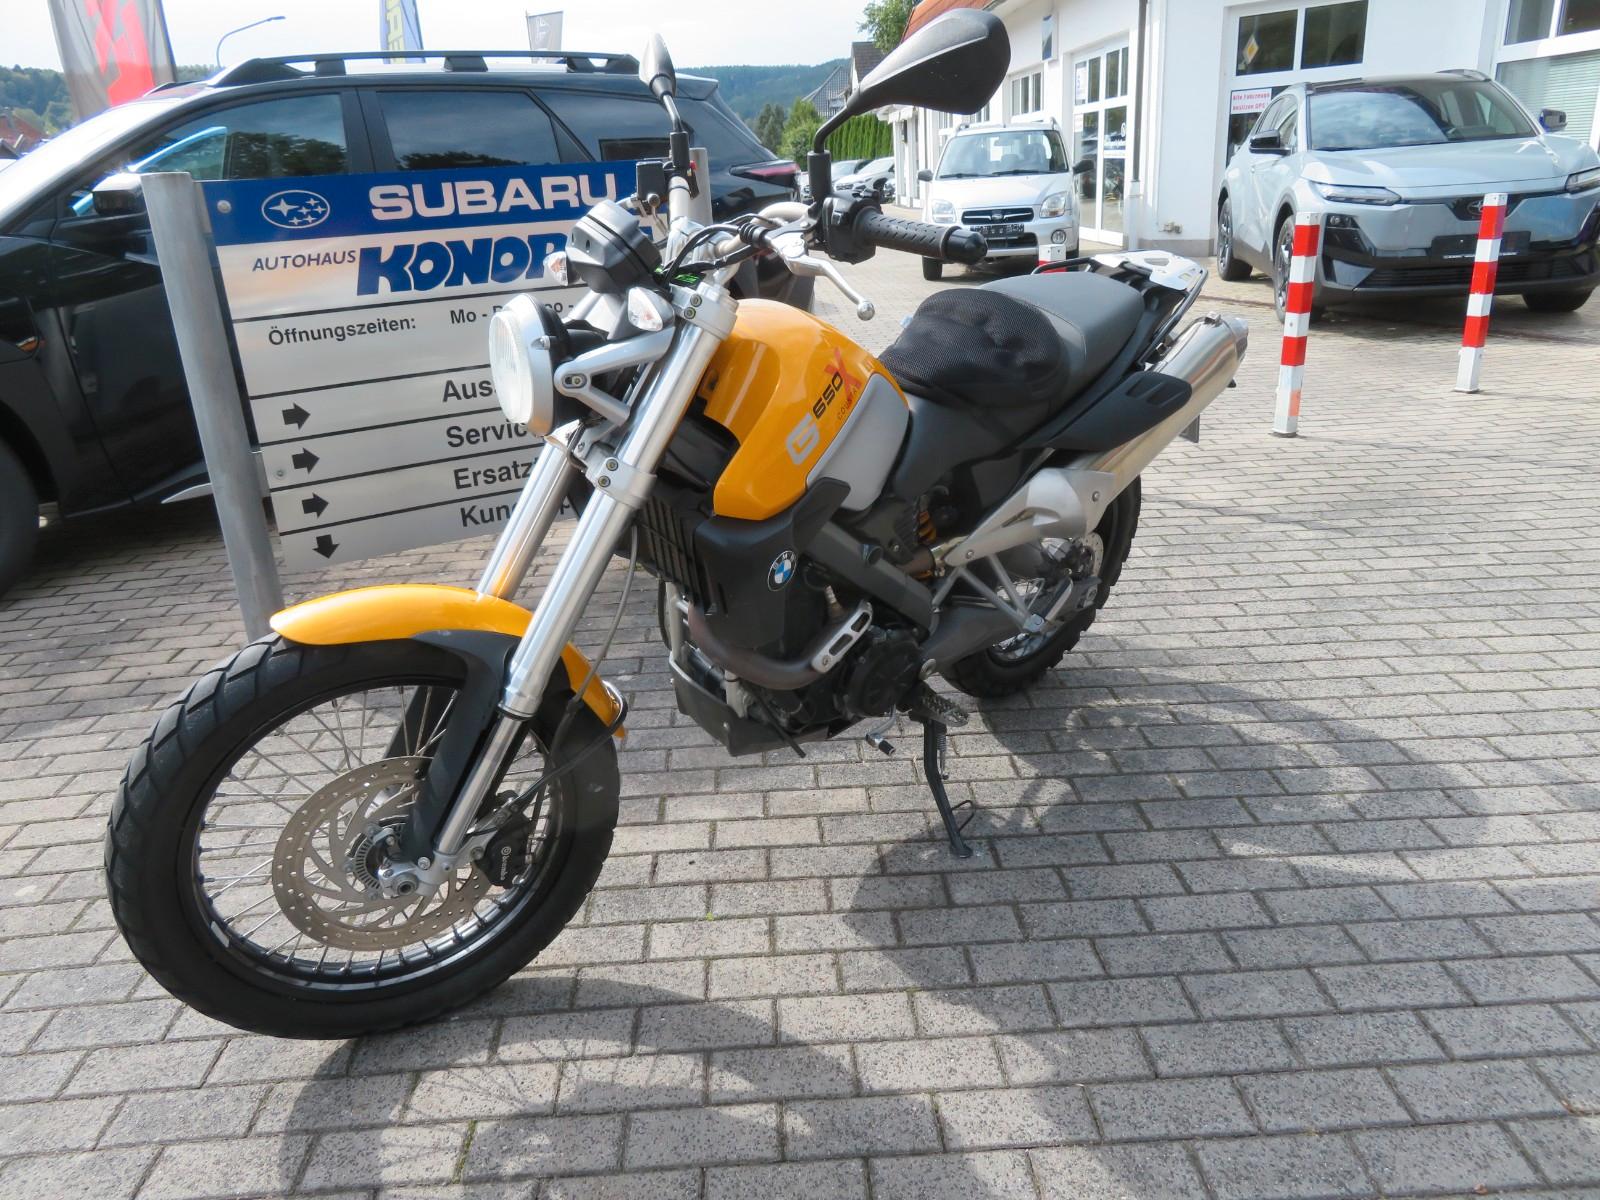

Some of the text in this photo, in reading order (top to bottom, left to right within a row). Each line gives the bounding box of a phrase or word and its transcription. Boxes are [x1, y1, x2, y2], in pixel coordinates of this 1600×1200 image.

[369, 173, 617, 221] SUBARU
[252, 250, 357, 272] AUTOHAUS
[268, 317, 417, 346] Öffnungszeiten:
[450, 309, 477, 325] Mo
[442, 379, 496, 402] Aus
[812, 371, 844, 420] 650
[446, 418, 529, 448] Servic
[454, 457, 539, 490] Ersatz
[460, 499, 515, 528] Kun
